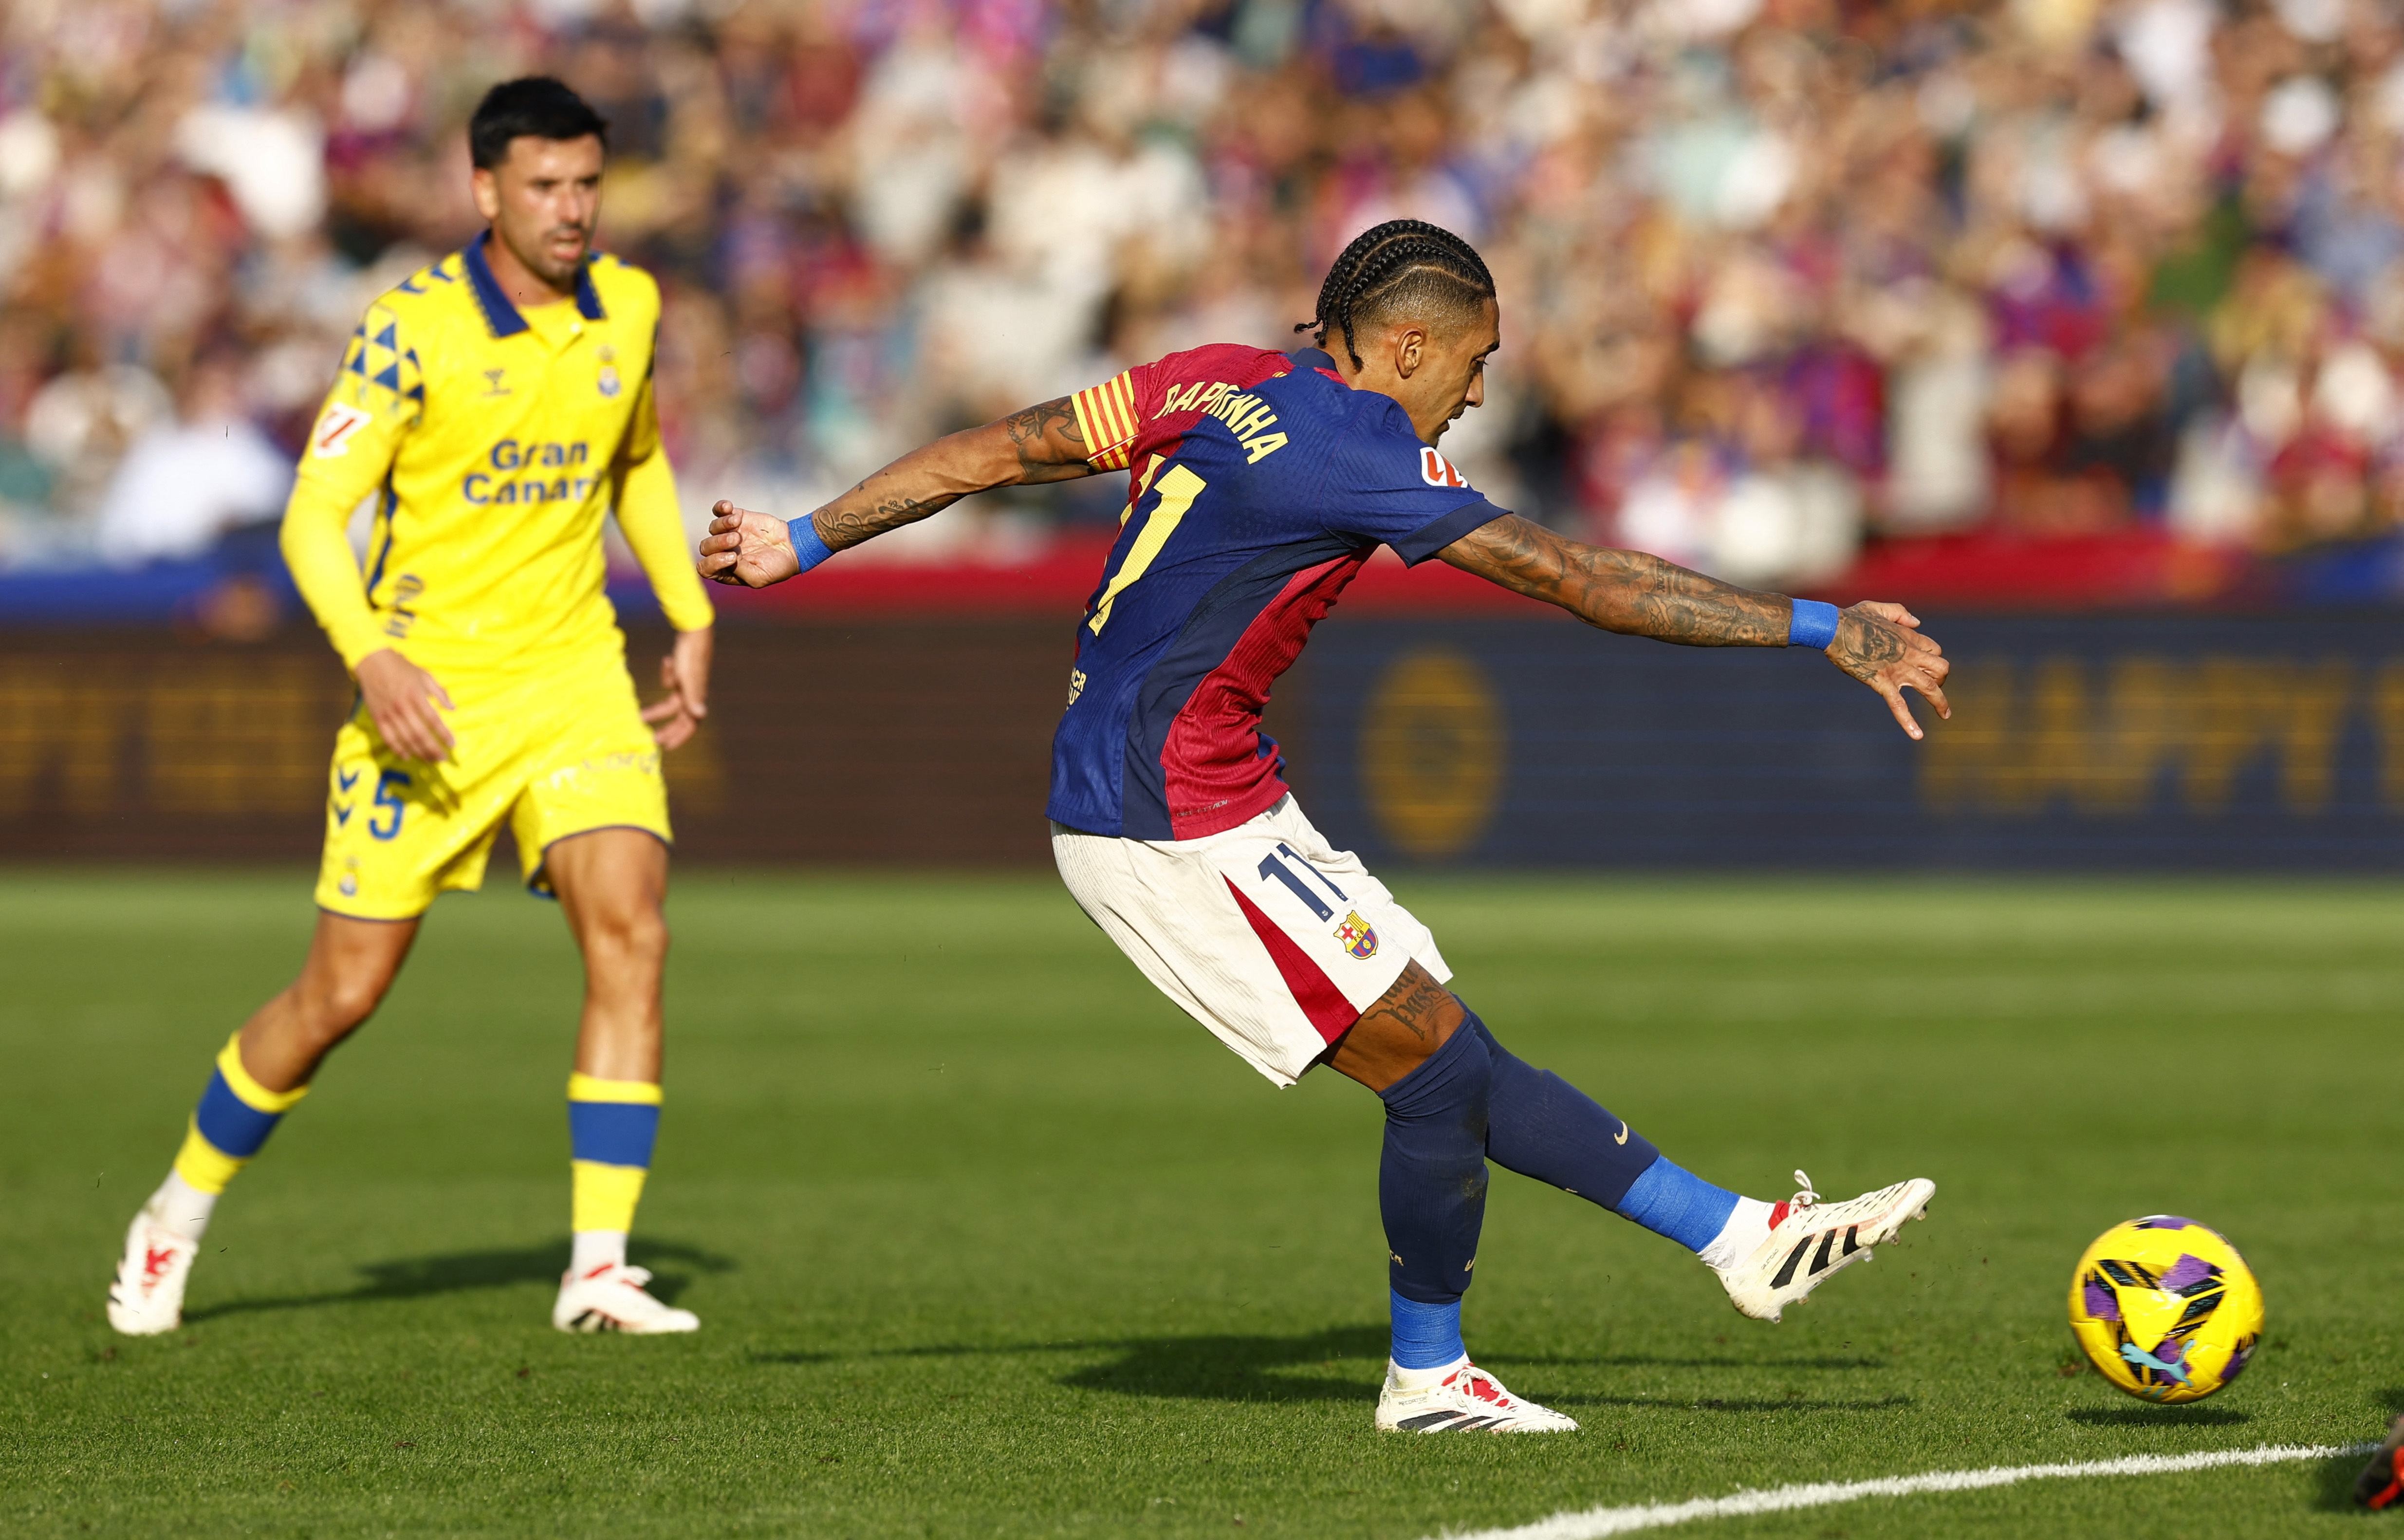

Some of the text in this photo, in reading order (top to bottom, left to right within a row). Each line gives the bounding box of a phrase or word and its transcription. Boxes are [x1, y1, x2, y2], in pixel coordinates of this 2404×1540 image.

[492, 438, 587, 470] Gran
[369, 769, 411, 841] 5
[1257, 842, 1349, 923] 11
